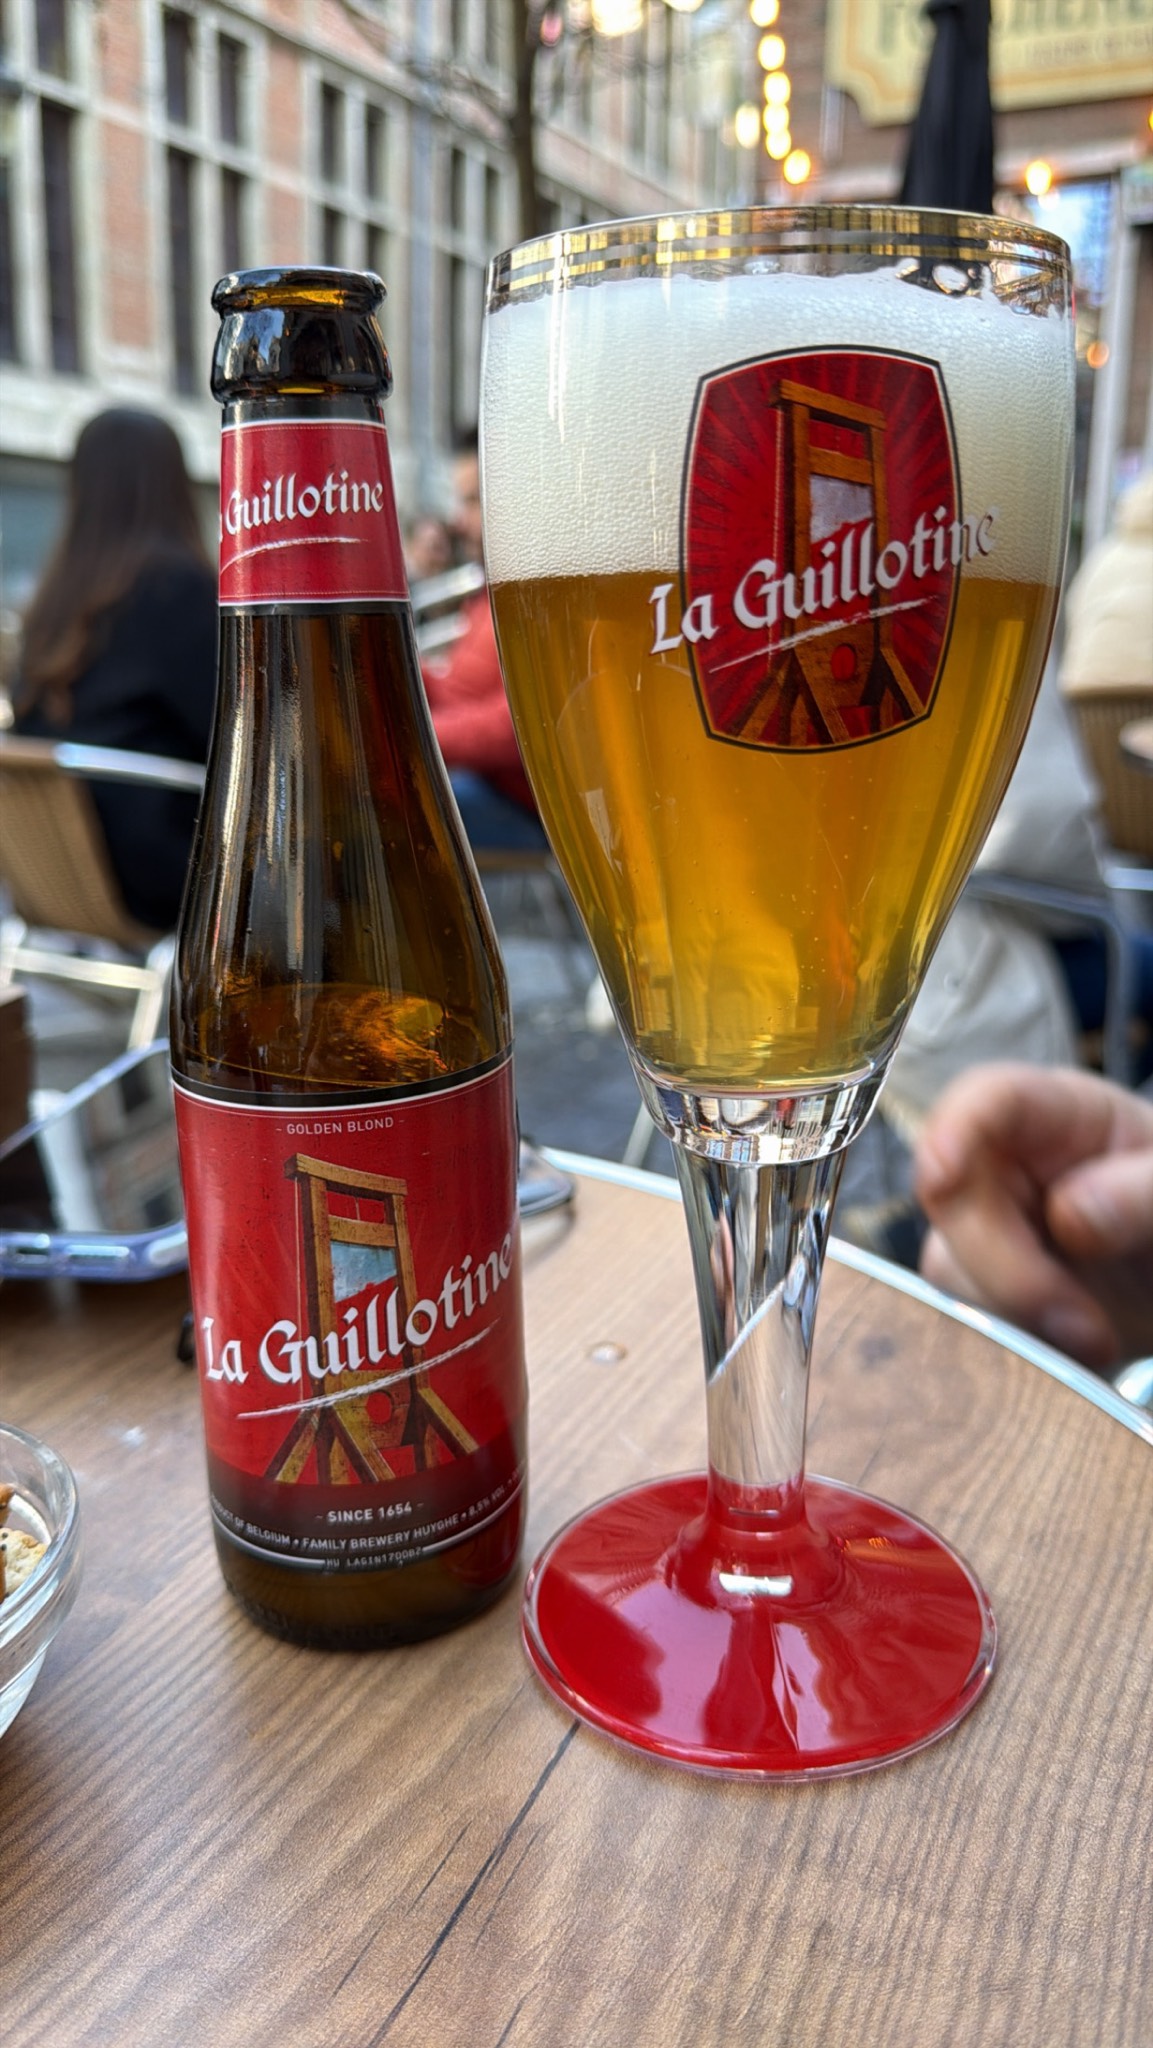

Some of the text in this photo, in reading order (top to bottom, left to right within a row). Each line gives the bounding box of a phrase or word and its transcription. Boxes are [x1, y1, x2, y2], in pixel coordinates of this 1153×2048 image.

[225, 470, 384, 536] Guillotine
[648, 504, 998, 655] La Guillotine
[286, 1117, 394, 1135] GOLDEN BLOND
[201, 1232, 514, 1385] La Guillotine
[246, 1522, 291, 1544] BELGIUM
[302, 1537, 347, 1550] FAMILY
[350, 1530, 411, 1549] BREWERY
[413, 1513, 460, 1538] HUYGHE
[327, 1501, 412, 1523] SINCE 1654
